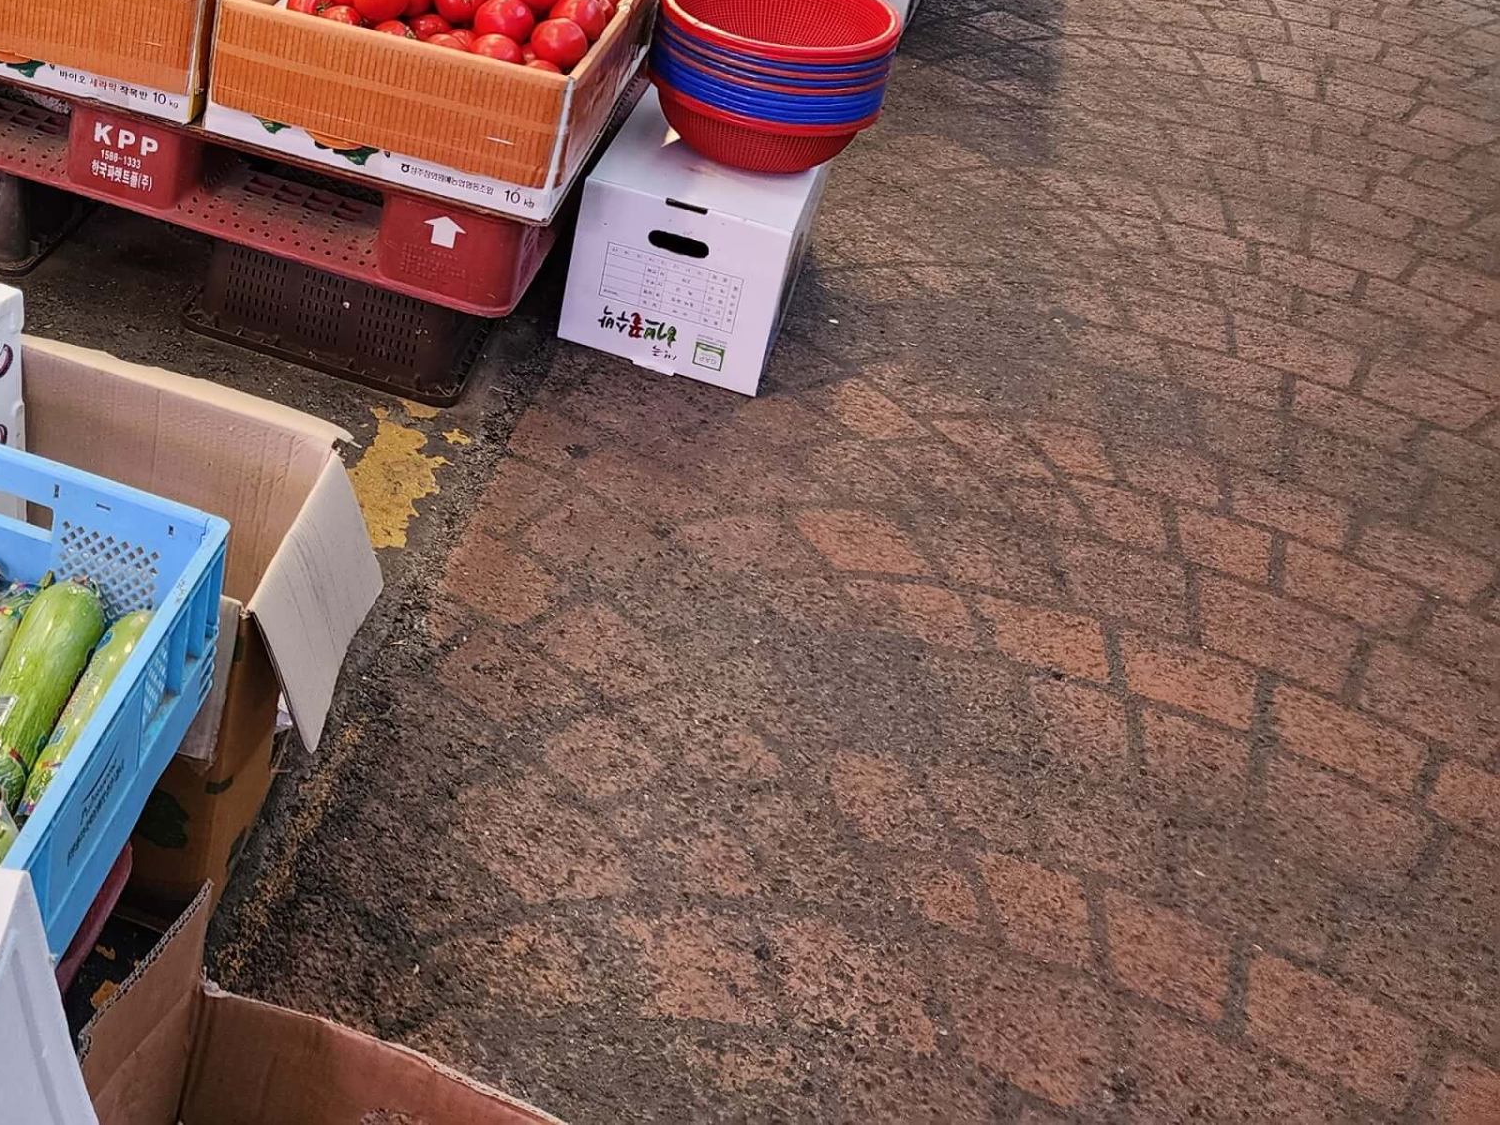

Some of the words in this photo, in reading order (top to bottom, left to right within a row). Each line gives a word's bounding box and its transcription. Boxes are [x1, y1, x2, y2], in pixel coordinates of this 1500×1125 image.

[59, 69, 87, 85] 바이오
[152, 91, 167, 105] 10
[168, 100, 180, 110] kg
[93, 121, 159, 157] KPP
[100, 149, 142, 170] 1588-1333
[504, 187, 521, 205] 10
